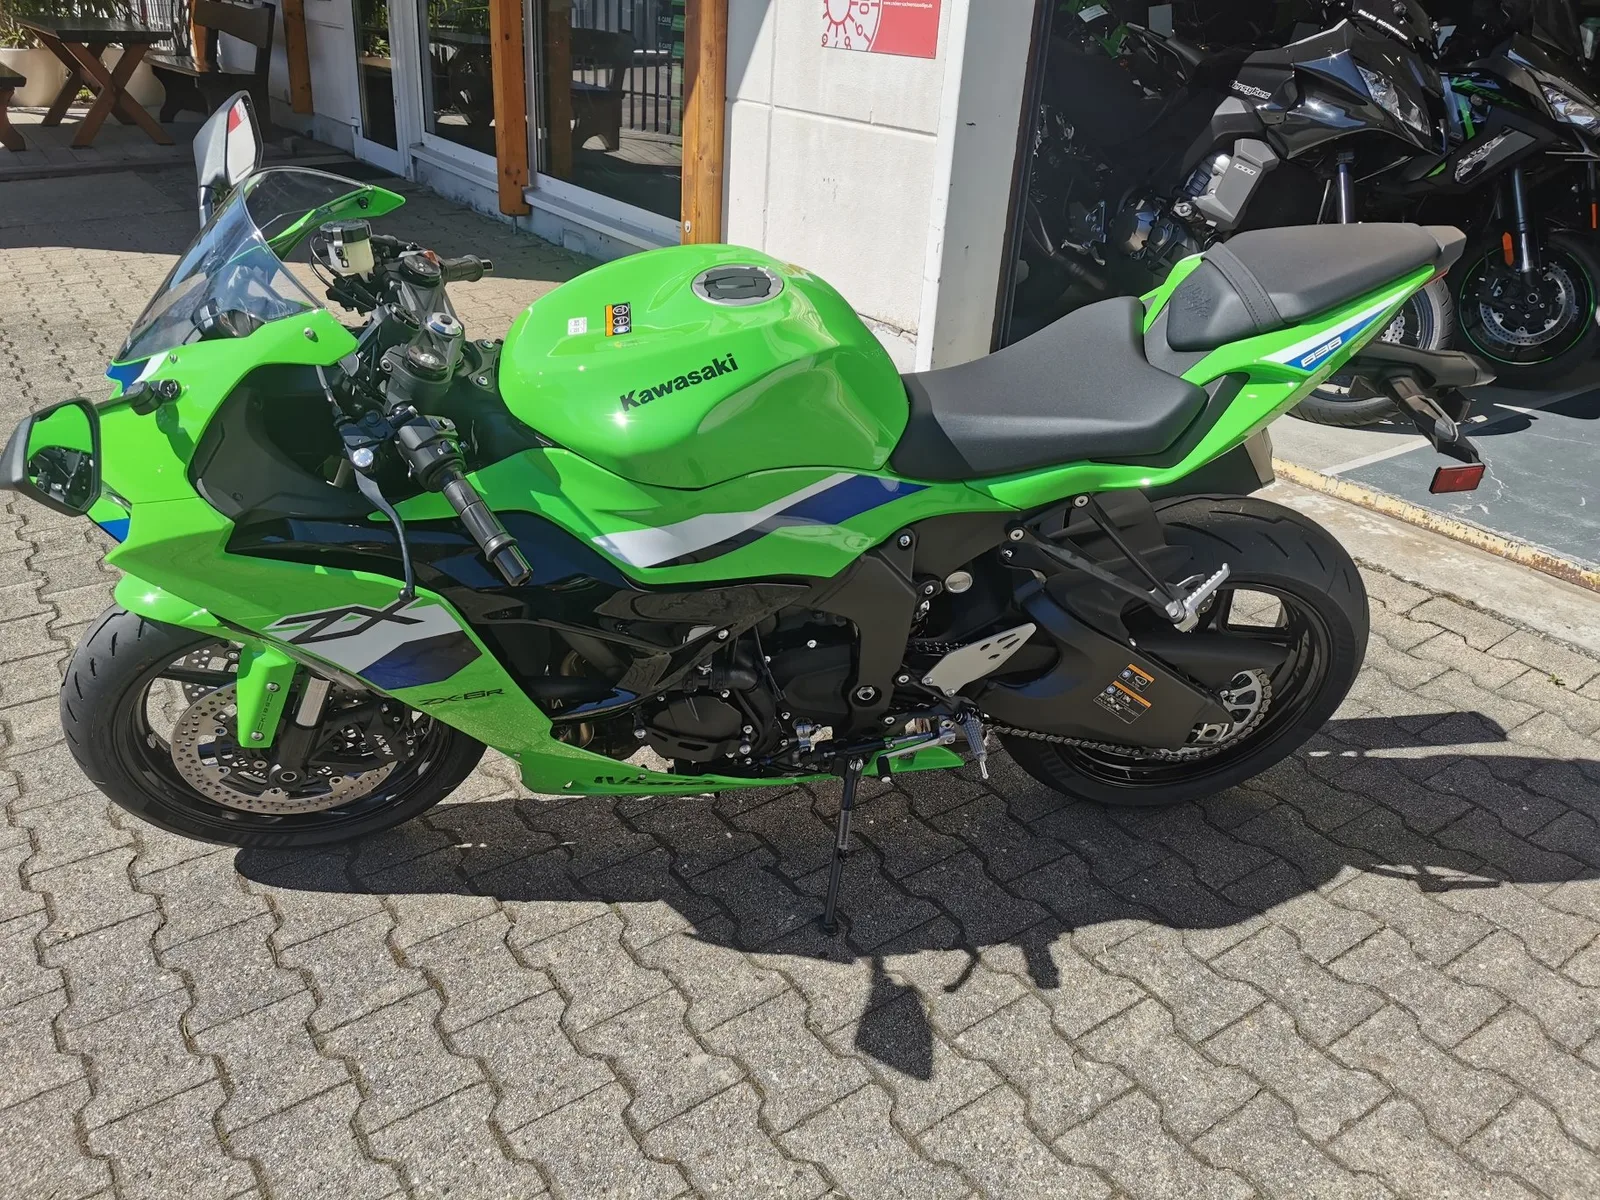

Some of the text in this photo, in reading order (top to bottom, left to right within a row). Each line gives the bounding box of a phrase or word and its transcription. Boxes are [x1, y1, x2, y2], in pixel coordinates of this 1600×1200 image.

[1234, 163, 1256, 176] 1000
[1301, 336, 1342, 368] 636
[620, 353, 739, 412] Kawasaki
[274, 596, 425, 646] ZX
[418, 688, 505, 706] ZX-6R
